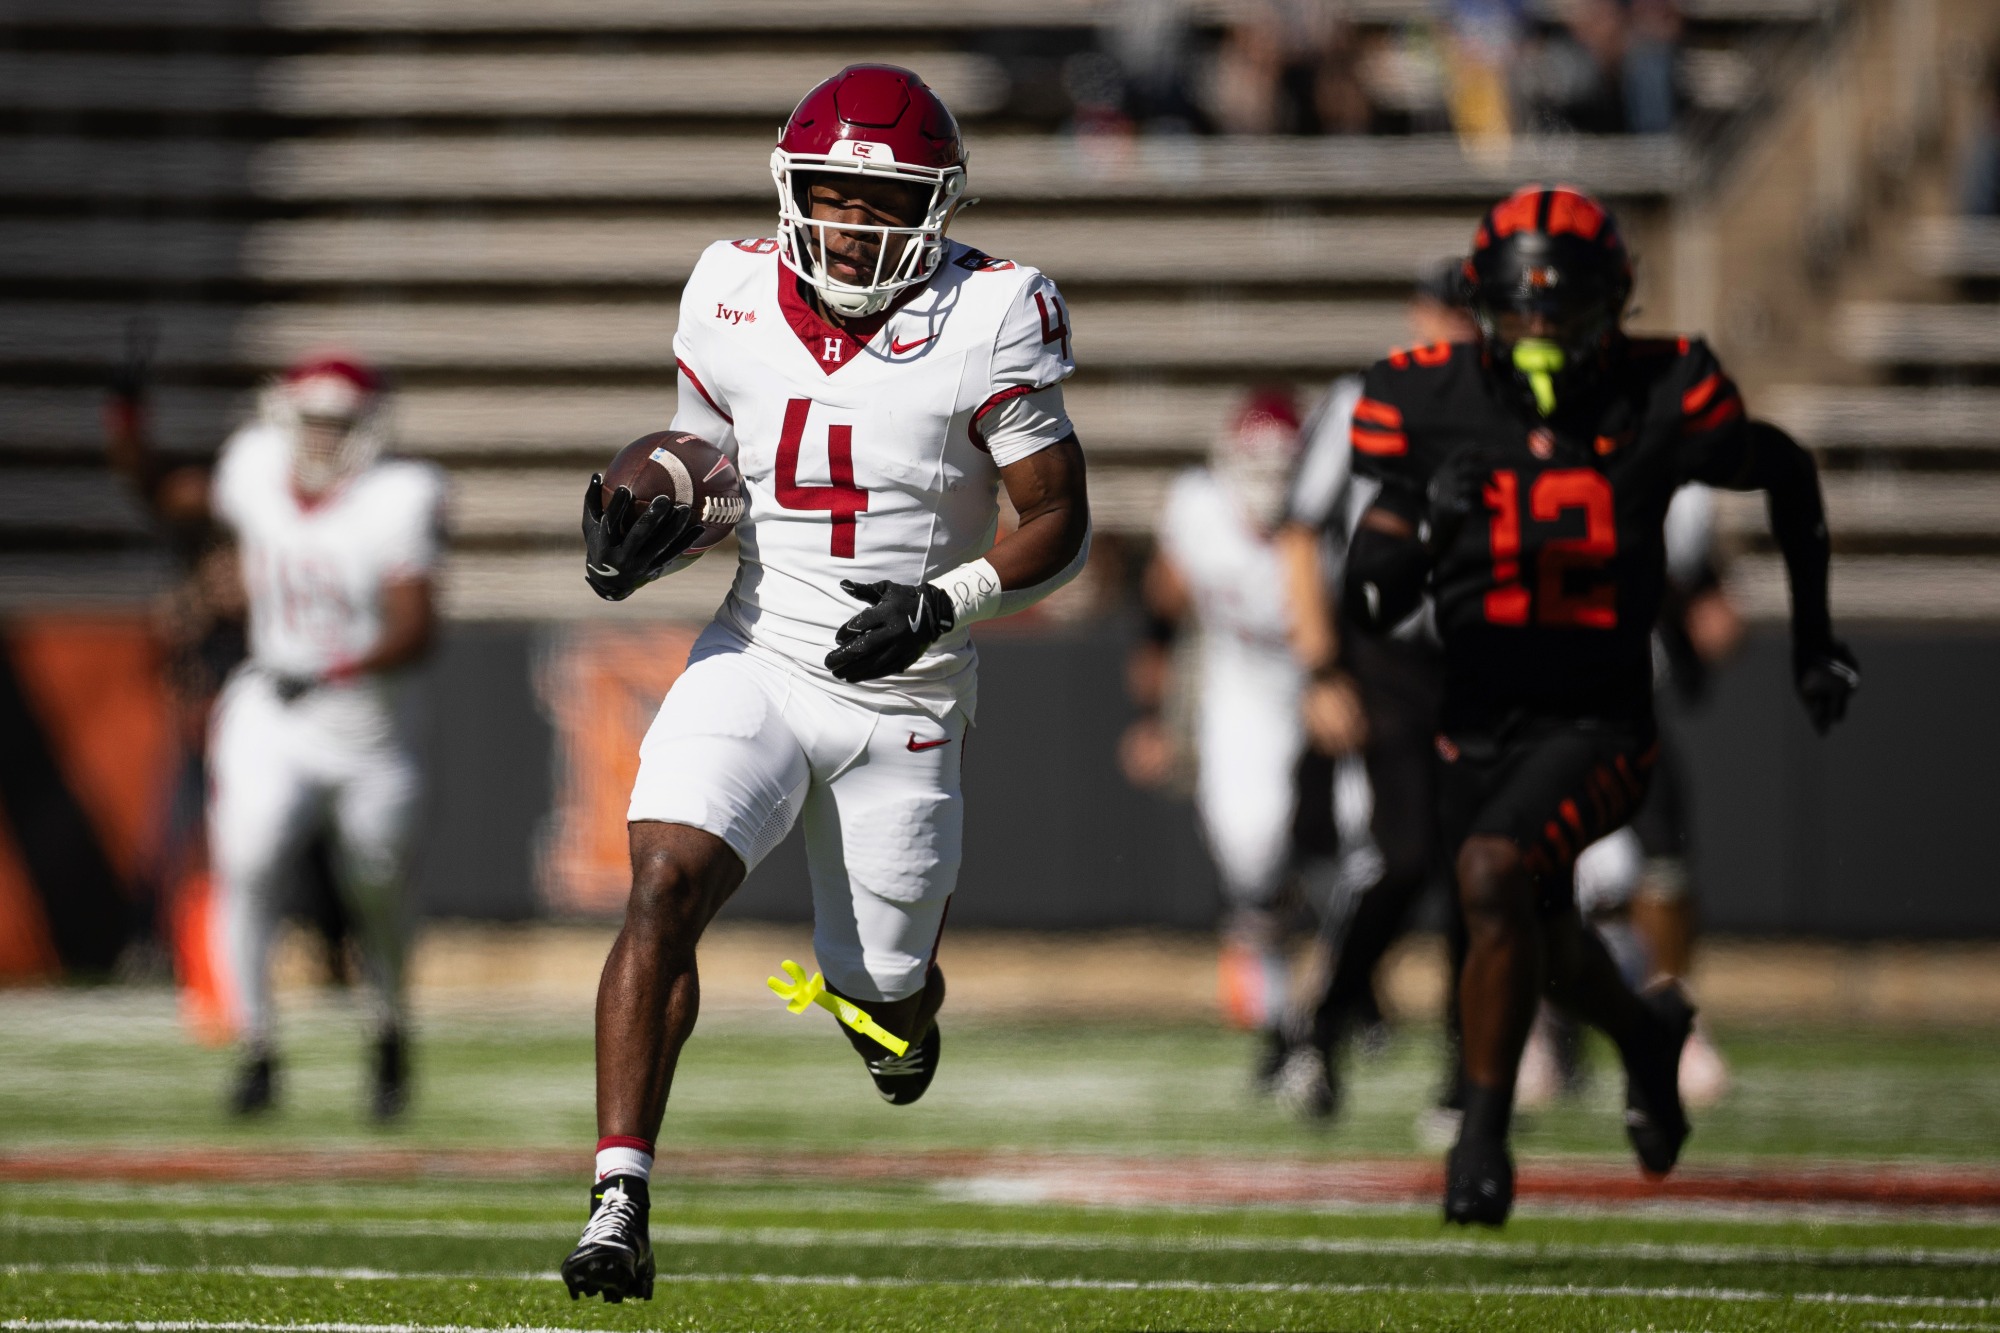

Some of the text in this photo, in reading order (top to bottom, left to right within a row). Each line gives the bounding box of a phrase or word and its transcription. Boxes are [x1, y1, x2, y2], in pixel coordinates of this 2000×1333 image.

[715, 303, 744, 325] Ivy
[1034, 291, 1068, 360] 4
[822, 336, 843, 362] H
[774, 398, 869, 559] 4
[1483, 468, 1618, 629] 12
